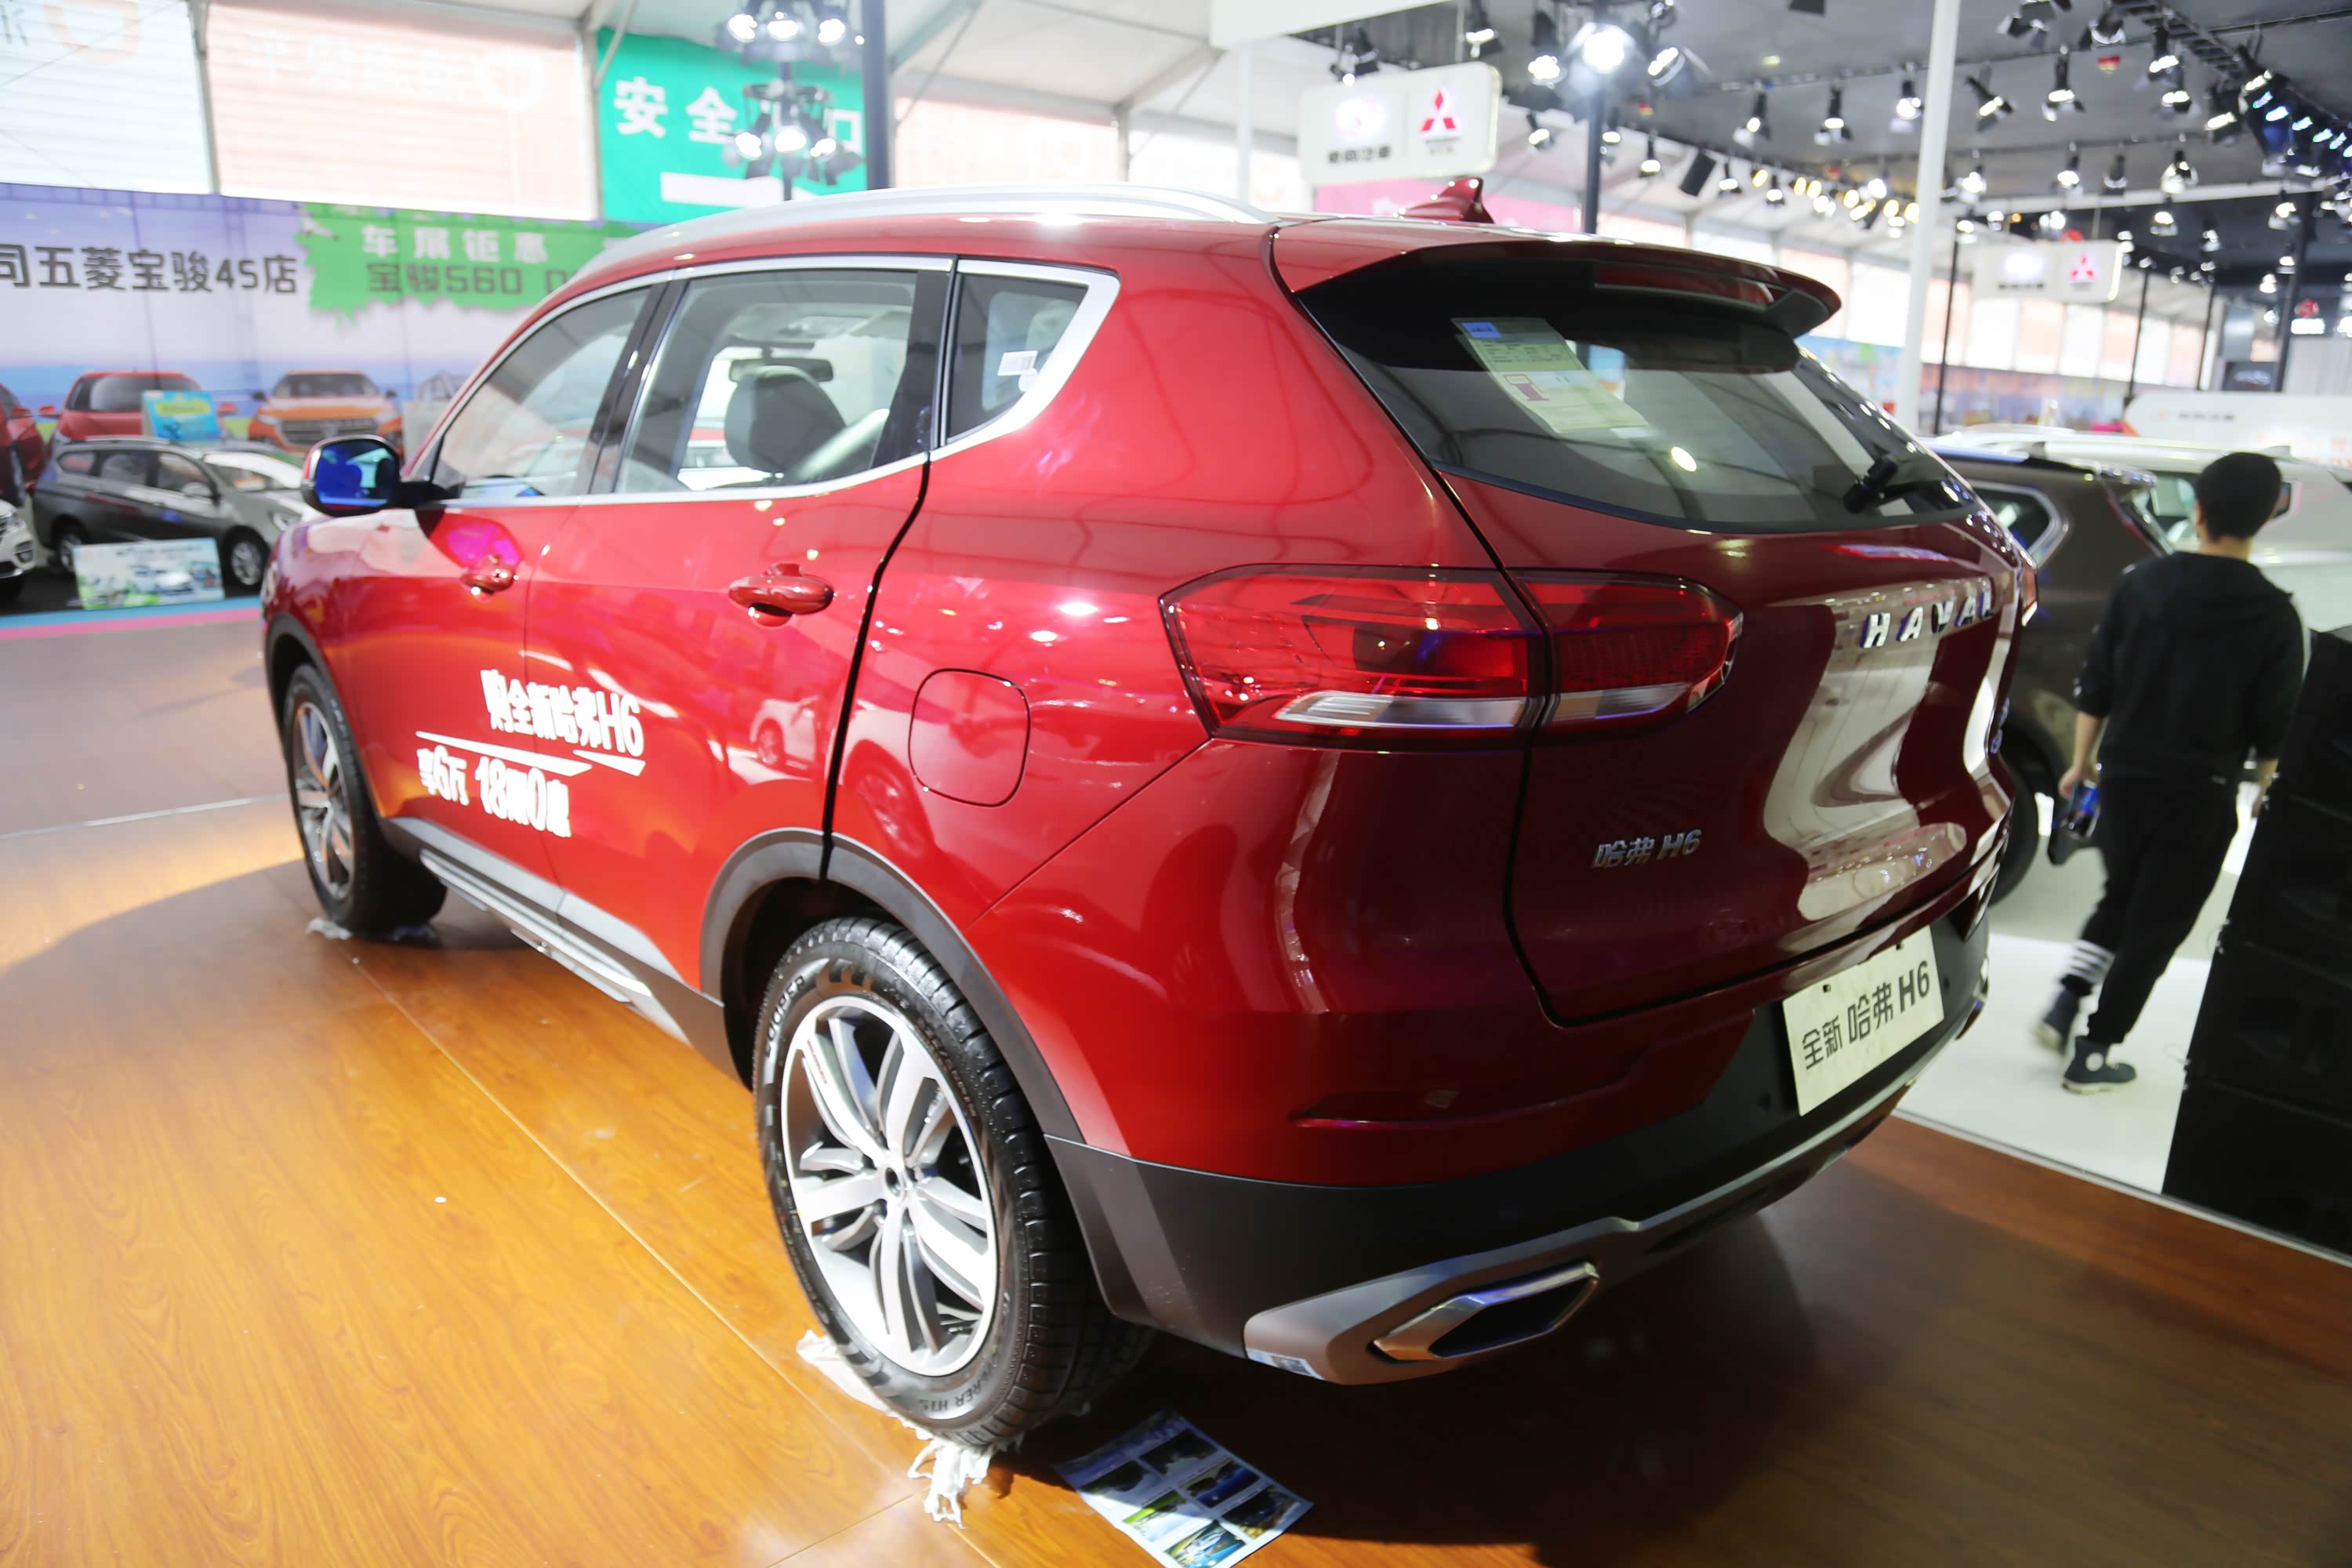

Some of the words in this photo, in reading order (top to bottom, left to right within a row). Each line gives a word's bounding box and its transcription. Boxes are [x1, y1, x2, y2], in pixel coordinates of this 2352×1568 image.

[614, 76, 862, 155] 安全口
[366, 263, 524, 295] 宝骏560
[1860, 589, 1994, 649] HAVAL
[1592, 837, 1655, 869] 哈弗
[1657, 829, 1702, 860] H6
[1802, 1015, 1843, 1070] 全新
[1847, 982, 1893, 1044] 哈弗
[1898, 960, 1930, 1014] H6
